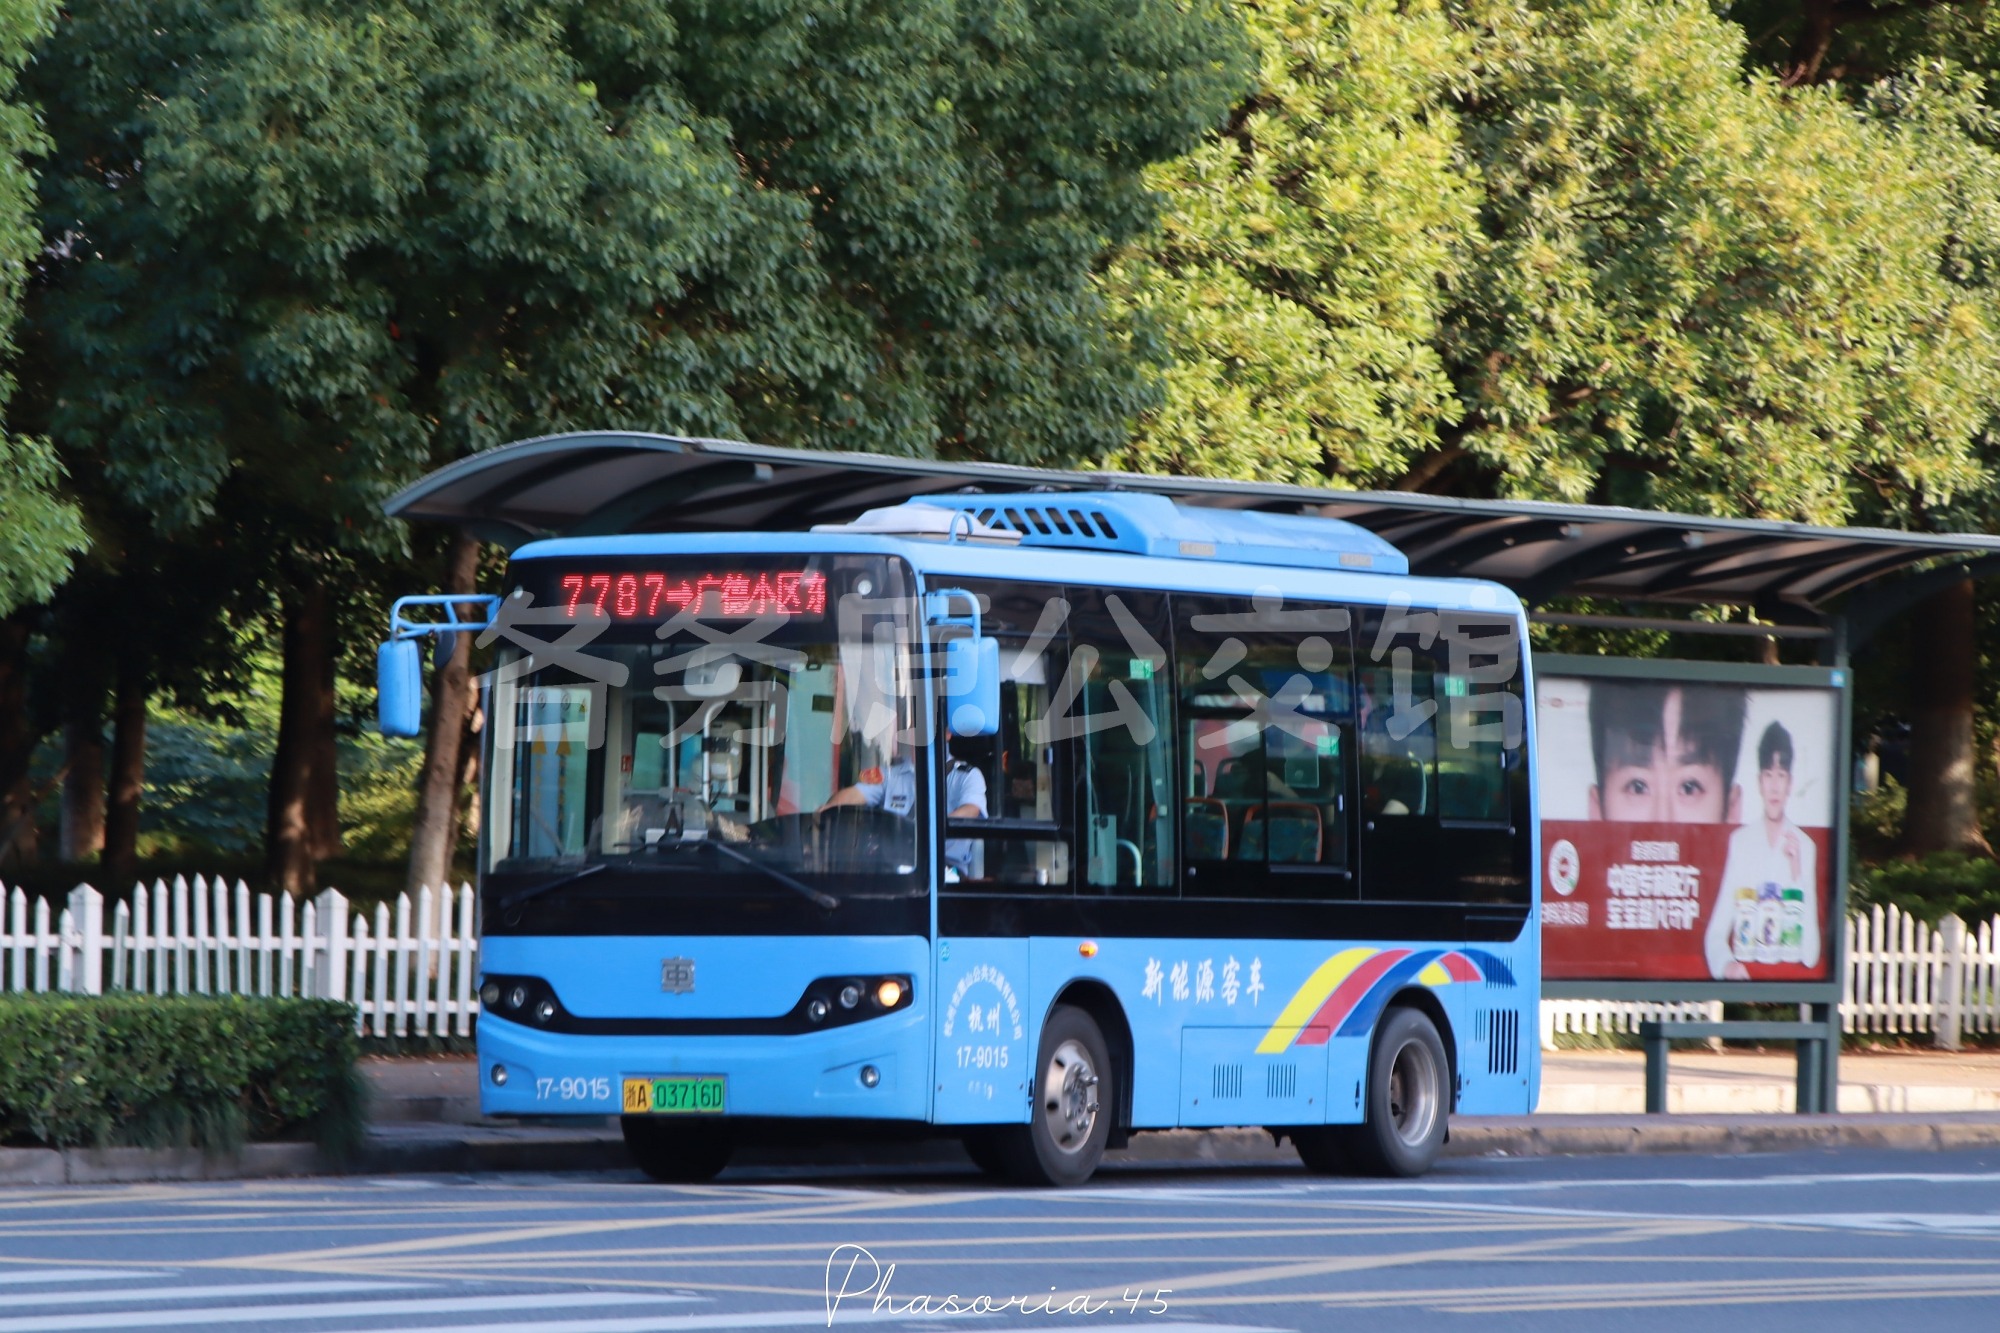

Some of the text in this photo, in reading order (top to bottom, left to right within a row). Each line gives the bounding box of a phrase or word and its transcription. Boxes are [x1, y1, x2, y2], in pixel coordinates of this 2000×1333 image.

[562, 574, 664, 616] 7787
[1142, 955, 1265, 1007] 新能源客车
[968, 1002, 1001, 1037] 杭州
[957, 1046, 1009, 1068] 17-9015
[536, 1077, 611, 1100] 17-9015
